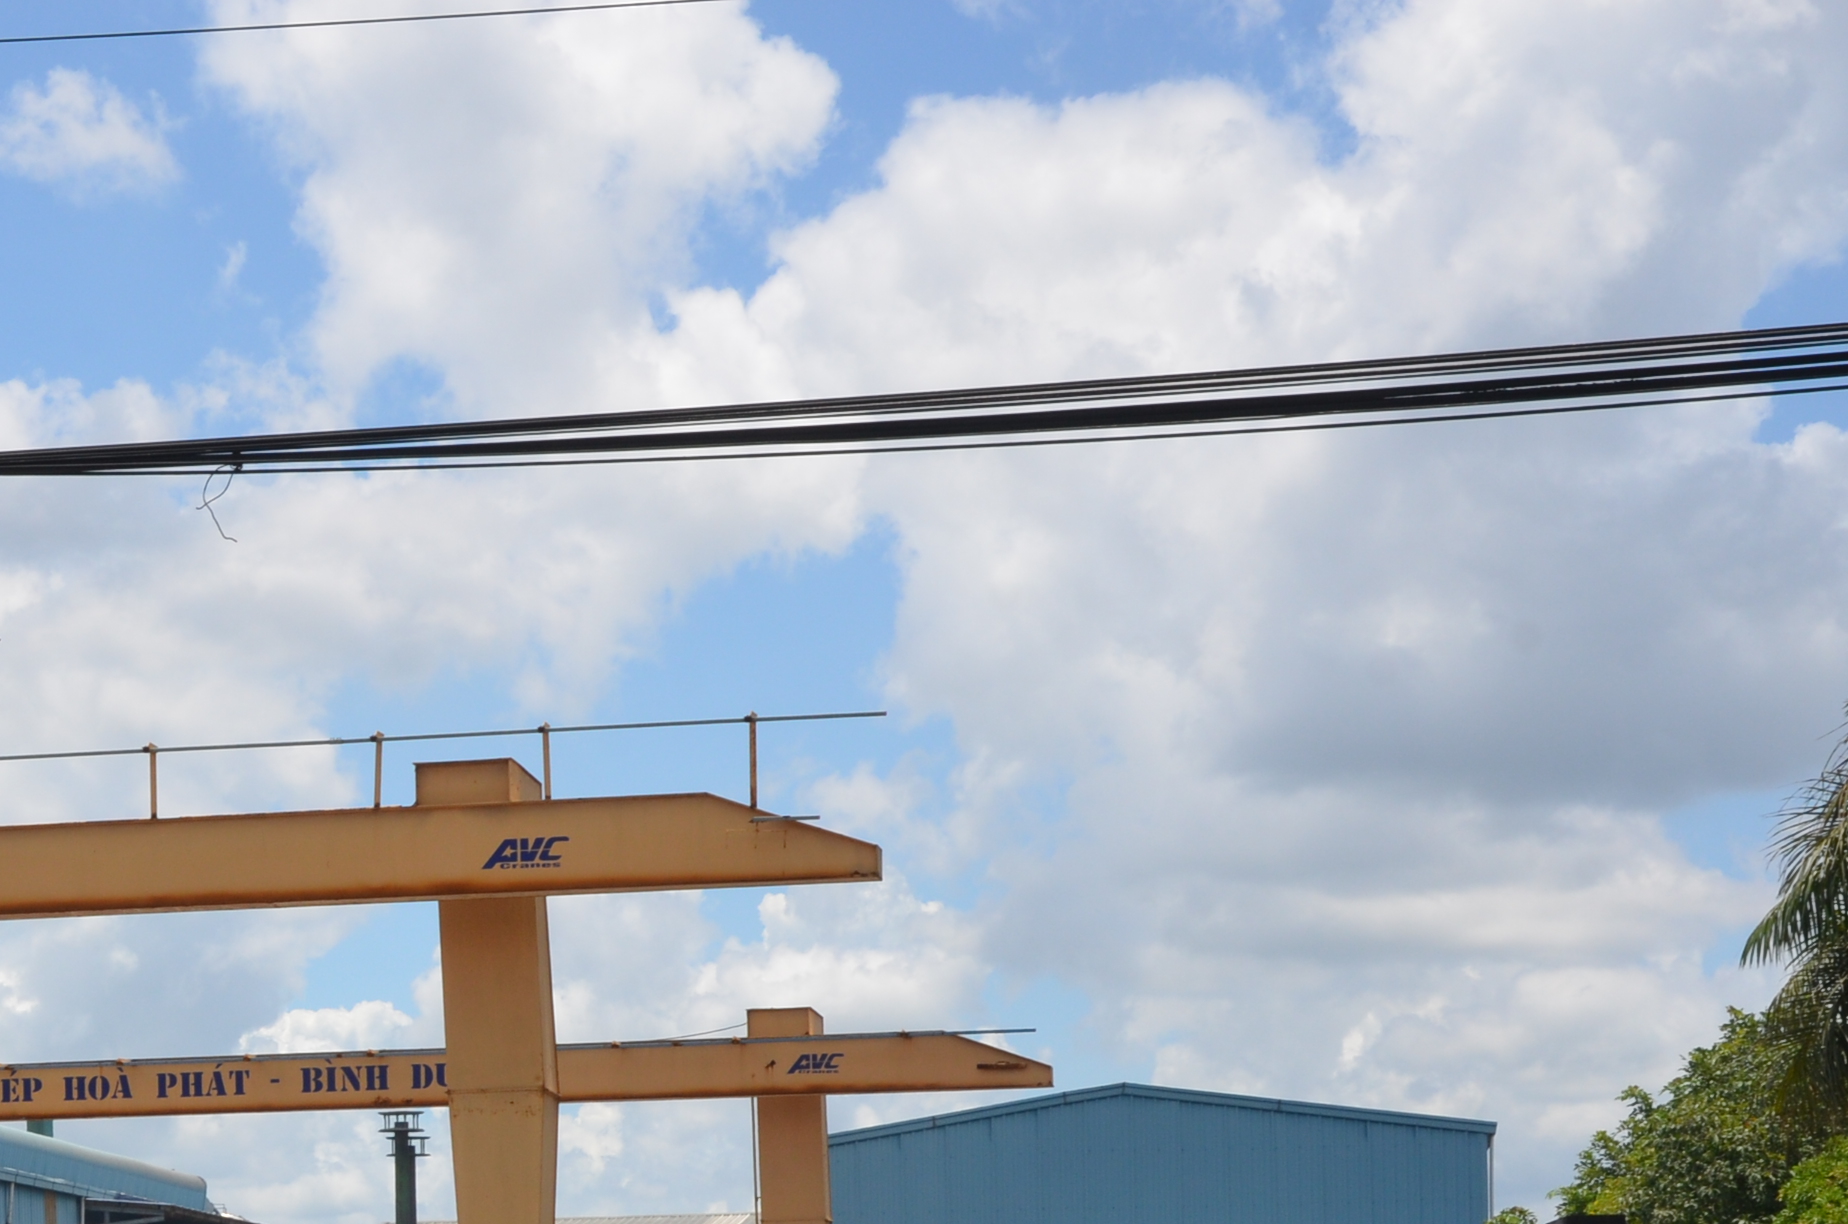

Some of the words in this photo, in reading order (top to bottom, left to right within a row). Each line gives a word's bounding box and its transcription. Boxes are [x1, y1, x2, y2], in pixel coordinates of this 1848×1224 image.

[481, 835, 570, 870] AVC
[63, 1066, 133, 1101] HOÀ
[156, 1062, 250, 1099] PHÁT
[300, 1058, 389, 1093] BÌNH
[787, 1053, 844, 1074] AVC
